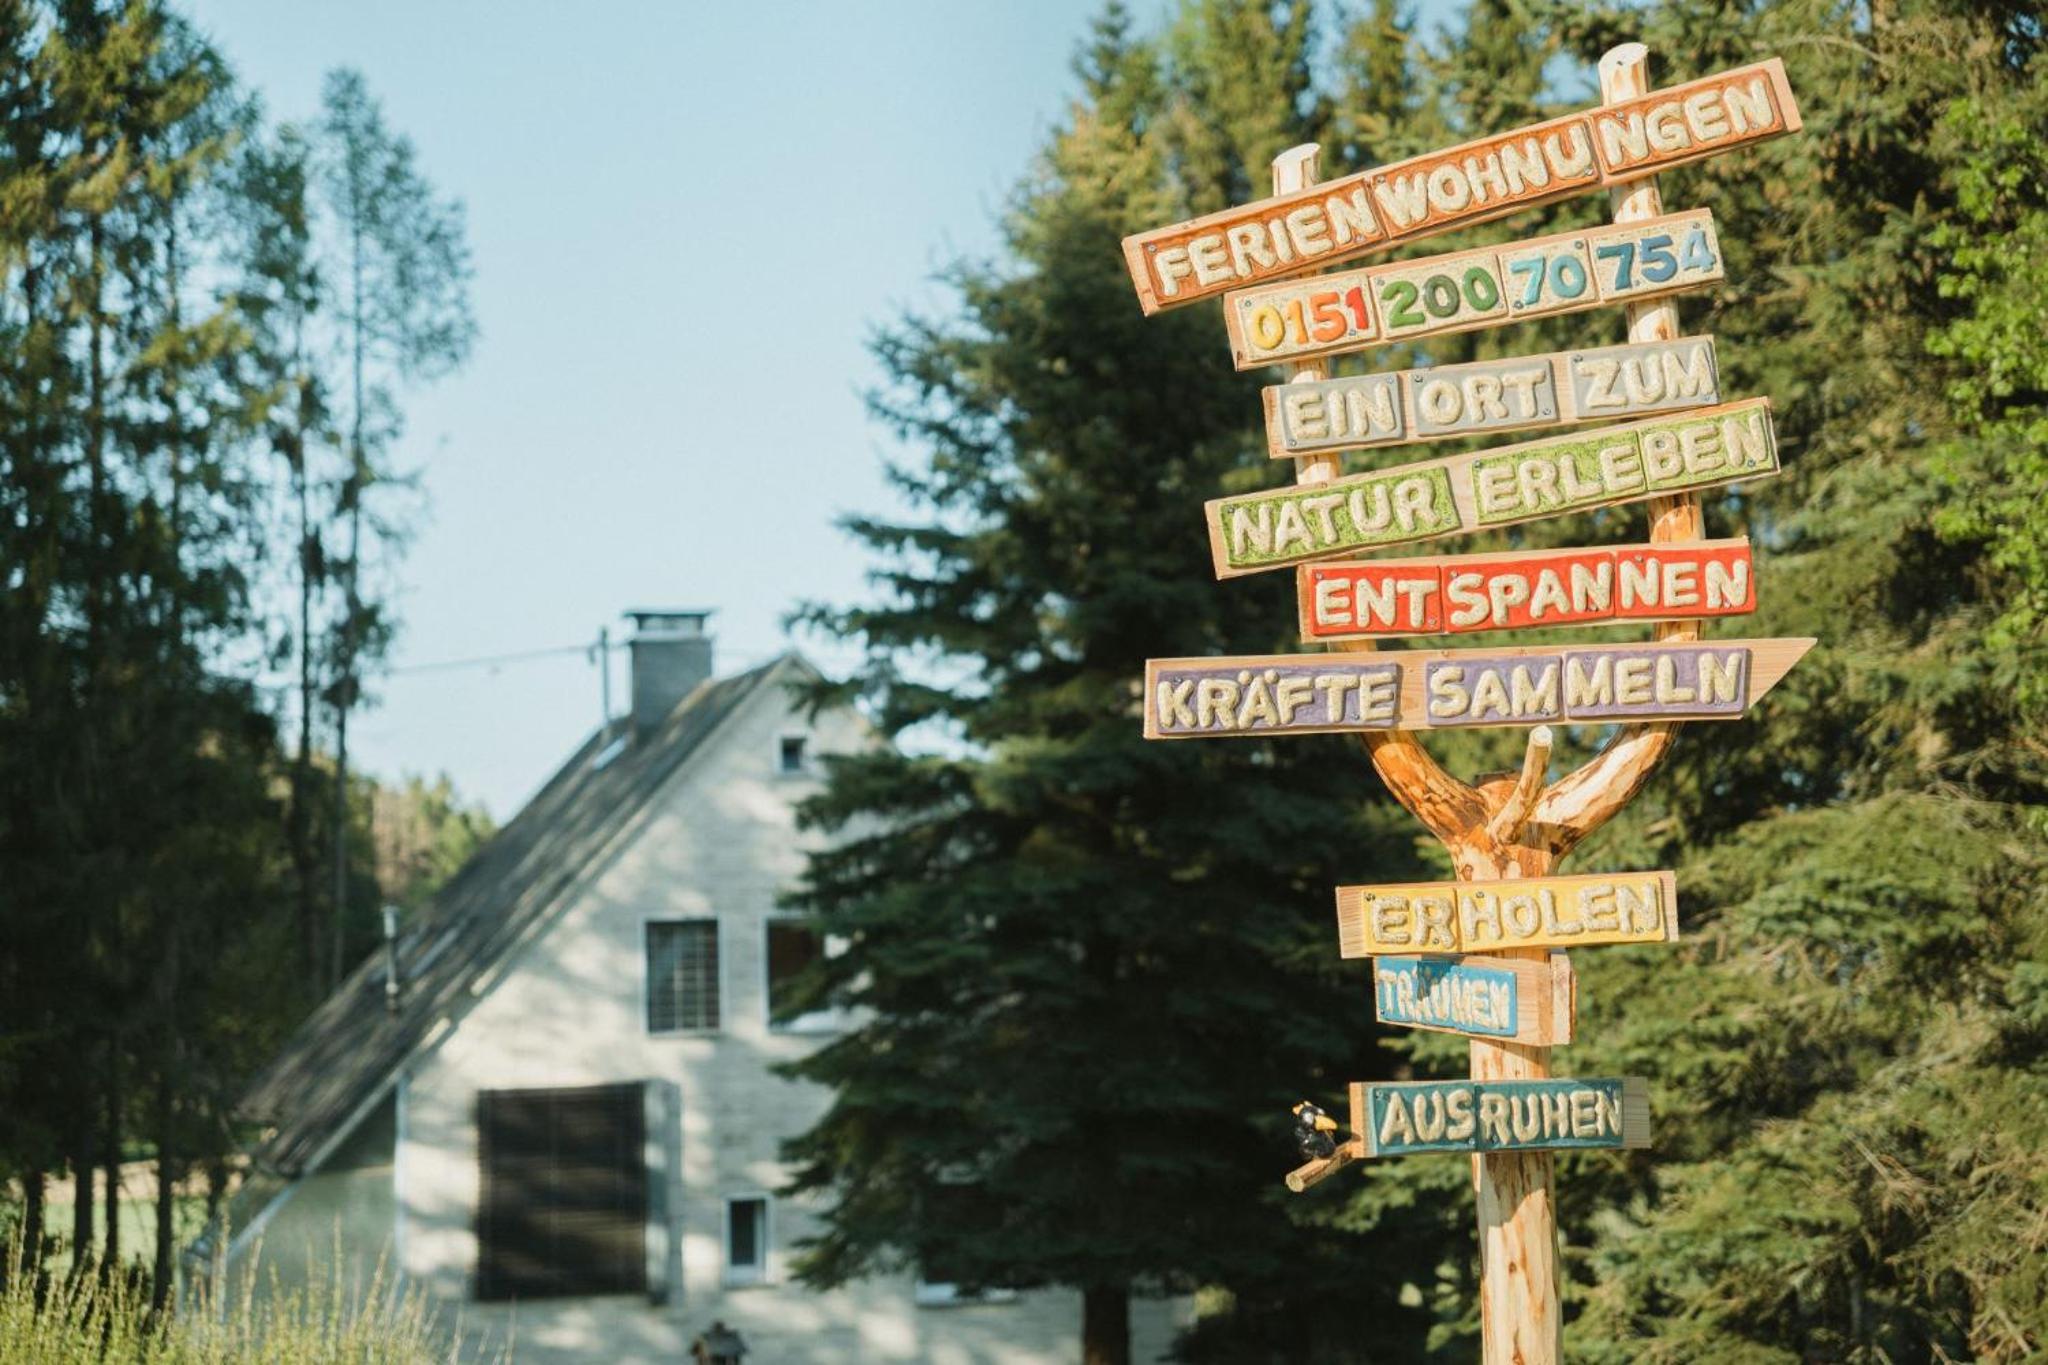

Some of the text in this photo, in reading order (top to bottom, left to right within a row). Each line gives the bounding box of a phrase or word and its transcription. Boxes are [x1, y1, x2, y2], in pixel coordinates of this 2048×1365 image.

[1154, 78, 1775, 297] FERIENWOHNUNGEN
[1249, 229, 1717, 350] 0151 200 70 754
[1285, 344, 1716, 440] EIN ORT ZUM
[1232, 413, 1769, 556] NATUR ERLEBEN
[1314, 557, 1749, 629] ENTSPANNEN
[1156, 652, 1742, 729] KRÄFTE SAMMELN
[1371, 882, 1662, 949] ERHOLEN
[1379, 1089, 1622, 1146] AUSRUHEN
